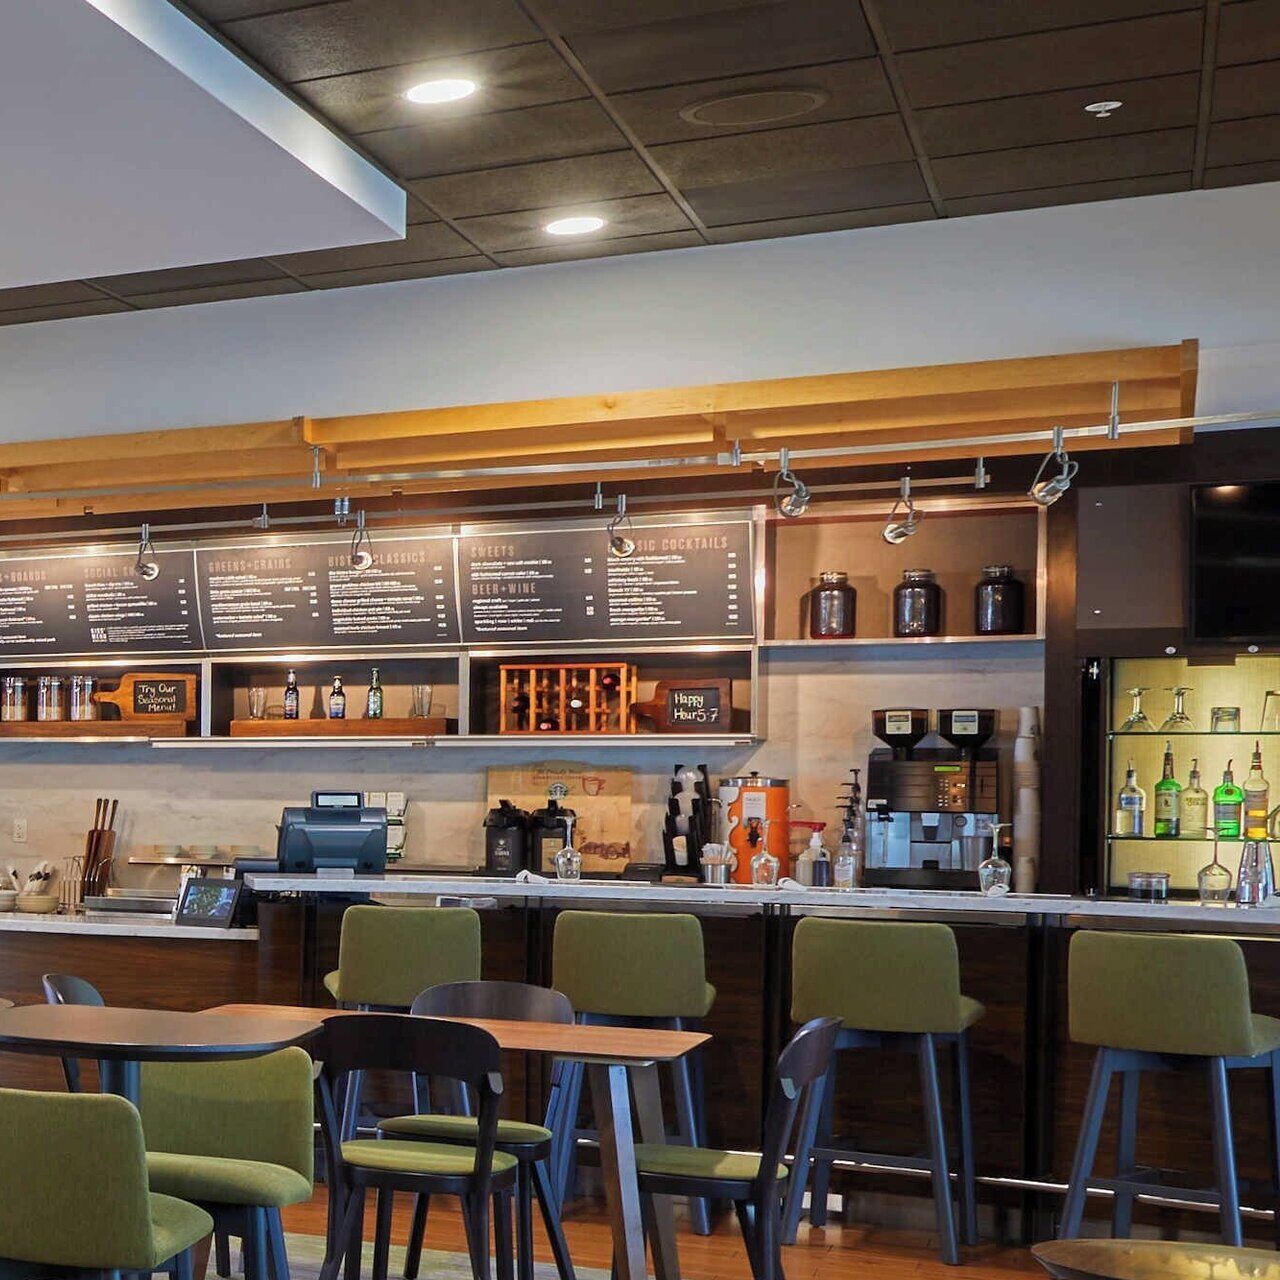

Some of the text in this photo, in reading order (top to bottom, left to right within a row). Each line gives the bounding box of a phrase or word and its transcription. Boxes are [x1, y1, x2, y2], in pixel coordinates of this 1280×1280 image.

[662, 536, 728, 551] COCKTAILS
[471, 545, 515, 558] SWEETS
[372, 552, 426, 566] CLASSICS
[84, 567, 118, 579] SOCIAL
[138, 682, 177, 698] Try Our
[137, 694, 176, 705] Seasonal
[674, 692, 704, 708] Happy
[148, 703, 176, 712] Menu!
[674, 708, 697, 720] Hour
